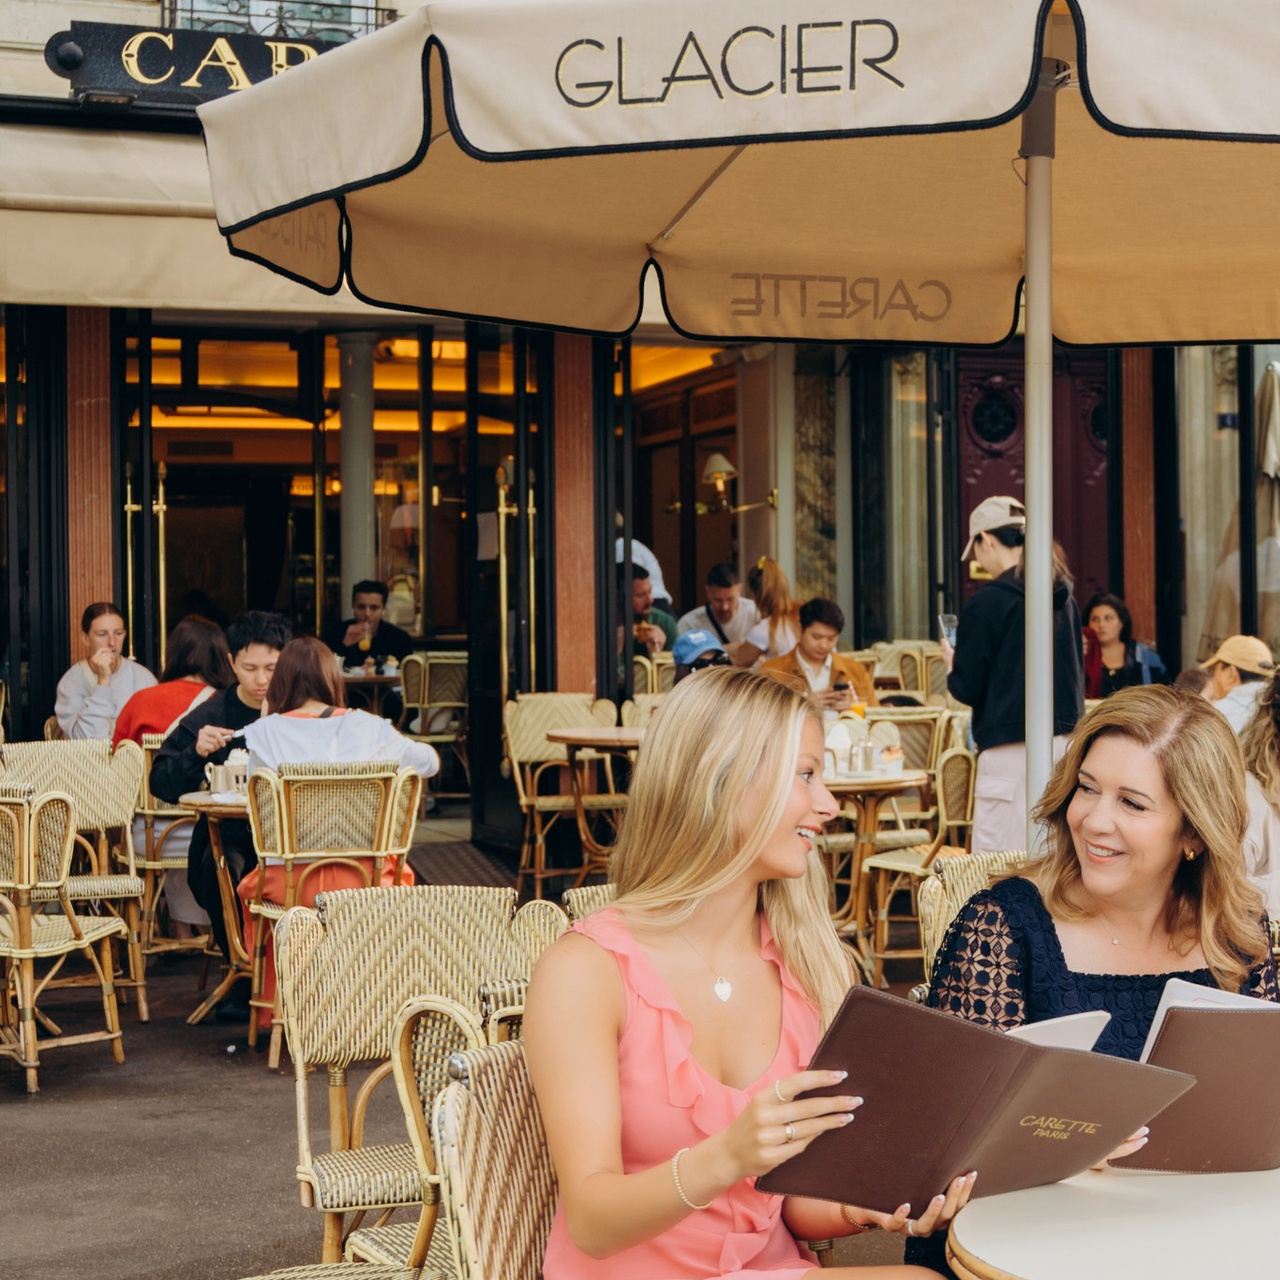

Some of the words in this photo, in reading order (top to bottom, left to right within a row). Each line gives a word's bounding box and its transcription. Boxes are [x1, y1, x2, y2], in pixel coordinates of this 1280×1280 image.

[555, 18, 906, 109] GLACIER
[1019, 1115, 1103, 1135] CARETTE
[1032, 1128, 1071, 1140] PARIS
